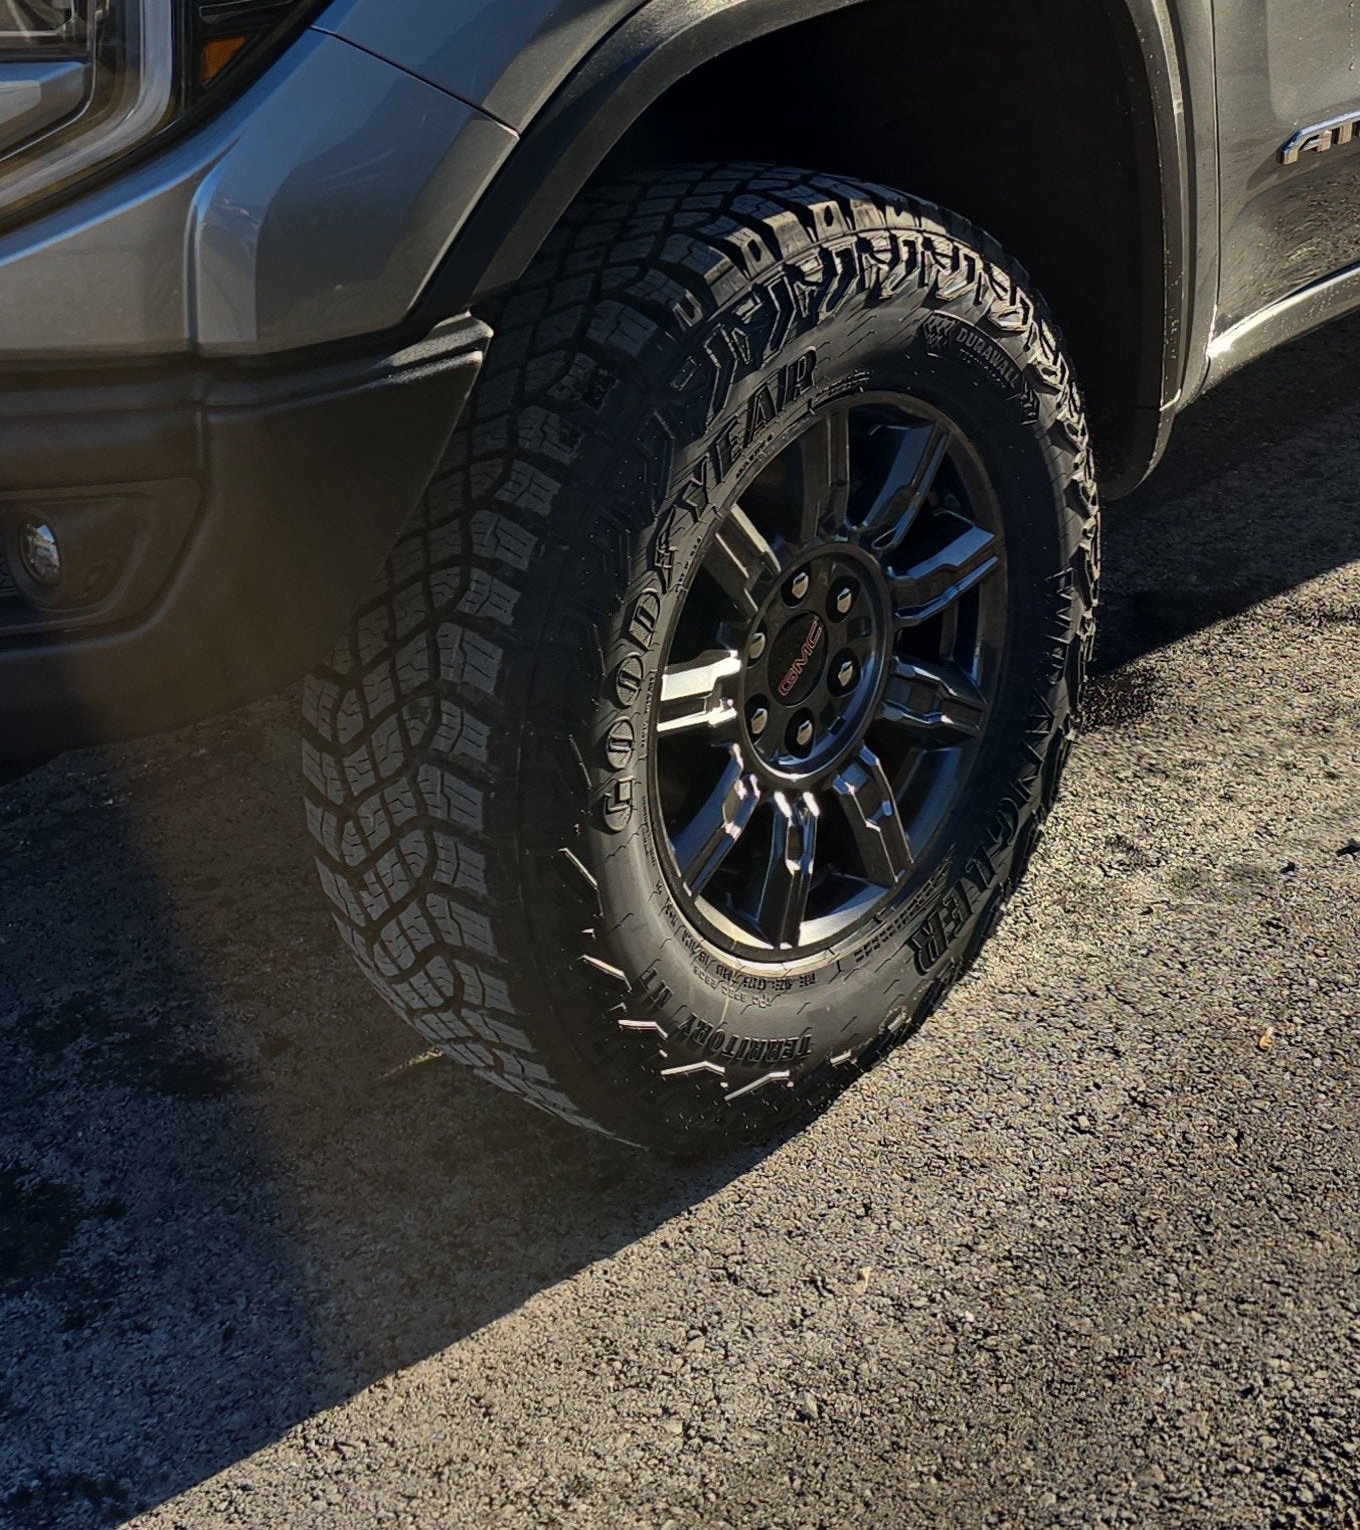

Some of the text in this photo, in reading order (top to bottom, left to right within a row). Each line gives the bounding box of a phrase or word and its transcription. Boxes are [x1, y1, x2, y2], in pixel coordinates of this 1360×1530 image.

[955, 326, 1019, 389] DURAWALL
[602, 345, 818, 832] GOODYEAR
[778, 620, 822, 696] GMC
[640, 967, 675, 1011] MT
[677, 1011, 813, 1063] TERRITORY
